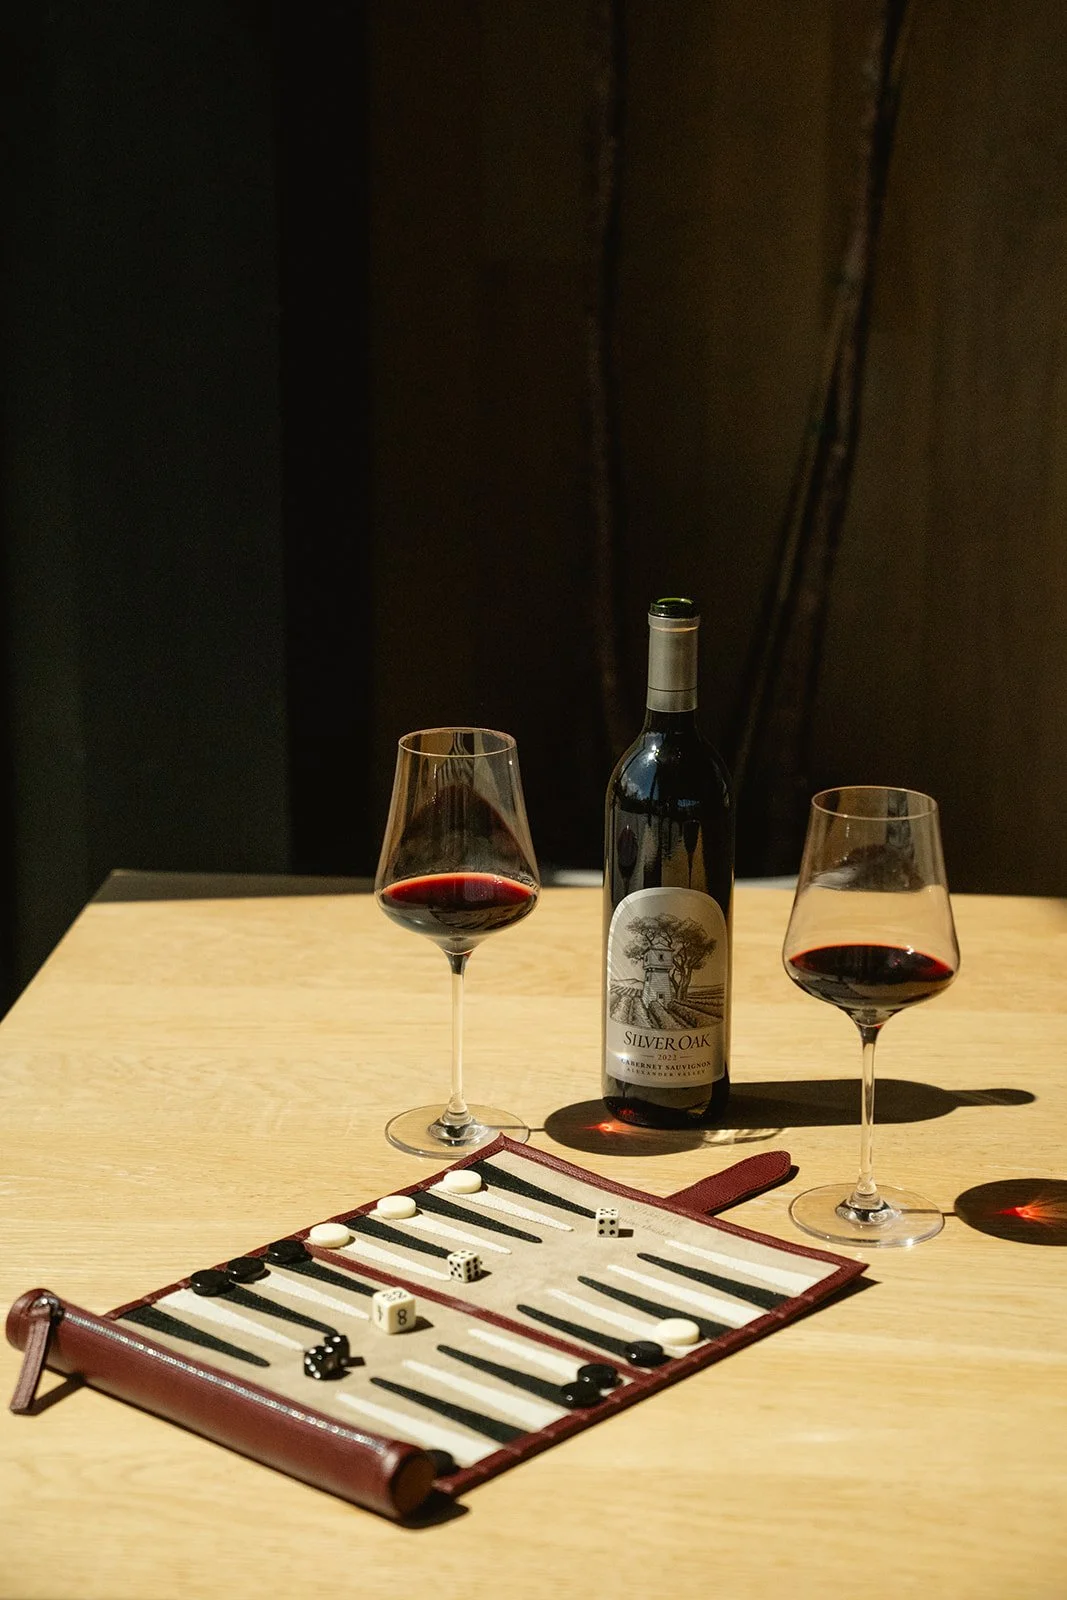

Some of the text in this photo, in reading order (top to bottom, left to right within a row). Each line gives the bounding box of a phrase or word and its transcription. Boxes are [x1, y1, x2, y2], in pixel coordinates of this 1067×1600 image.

[623, 1031, 711, 1051] SILVER OAK
[657, 1053, 677, 1061] 2022
[621, 1058, 711, 1071] CABERNET SAUVIGNON
[627, 1067, 706, 1077] ALEXANDER VALLEY
[397, 1308, 407, 1326] 8
